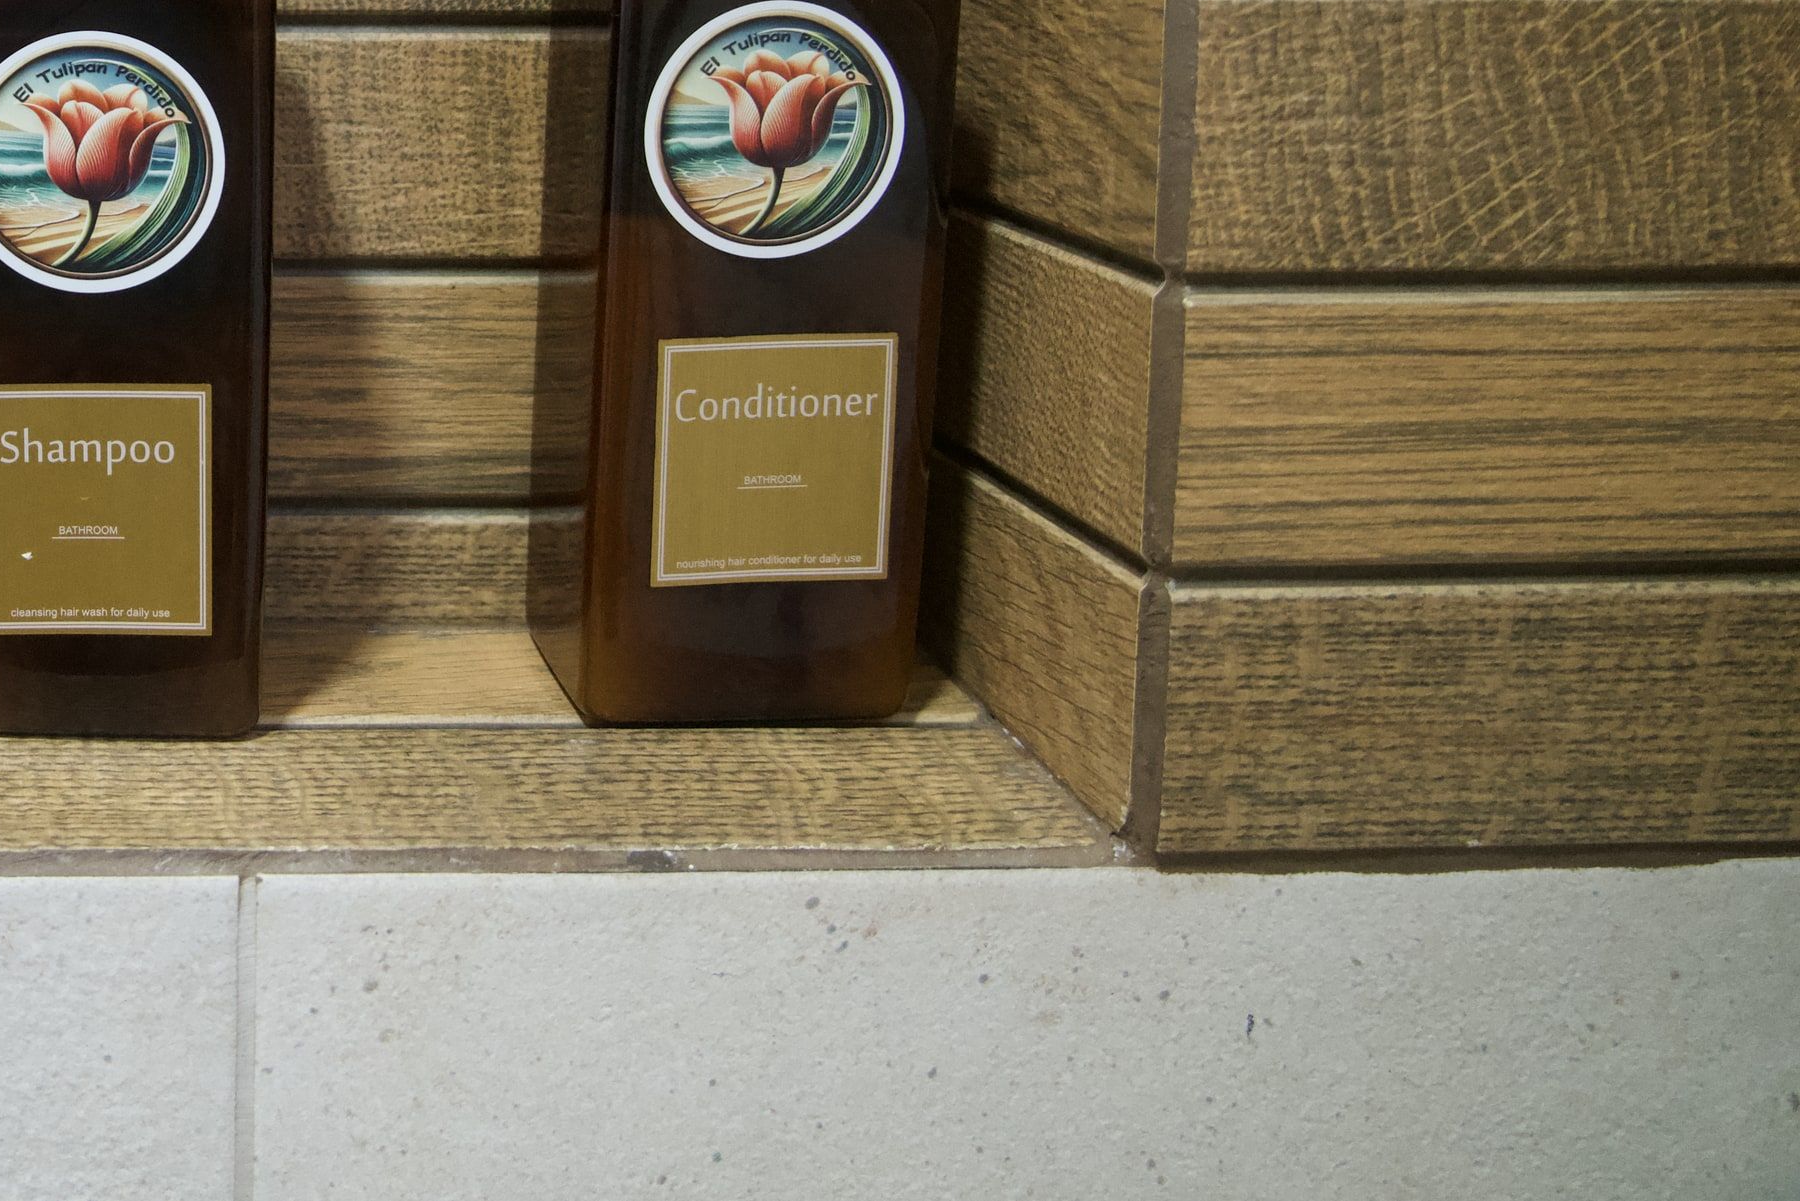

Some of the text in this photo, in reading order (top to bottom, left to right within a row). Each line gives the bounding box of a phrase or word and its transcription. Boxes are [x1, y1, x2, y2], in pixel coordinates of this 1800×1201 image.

[700, 31, 856, 81] El Tulipan Perdido
[12, 61, 175, 118] El Tulipan Perdido
[675, 383, 878, 423] Conditioner
[0, 428, 175, 476] Shampoo
[743, 475, 802, 485] BATHROOM
[59, 525, 118, 535] BATHROOM
[676, 553, 862, 569] nourishing hair conditioner for daily use
[10, 608, 170, 619] cleansing hair wash for daily use
